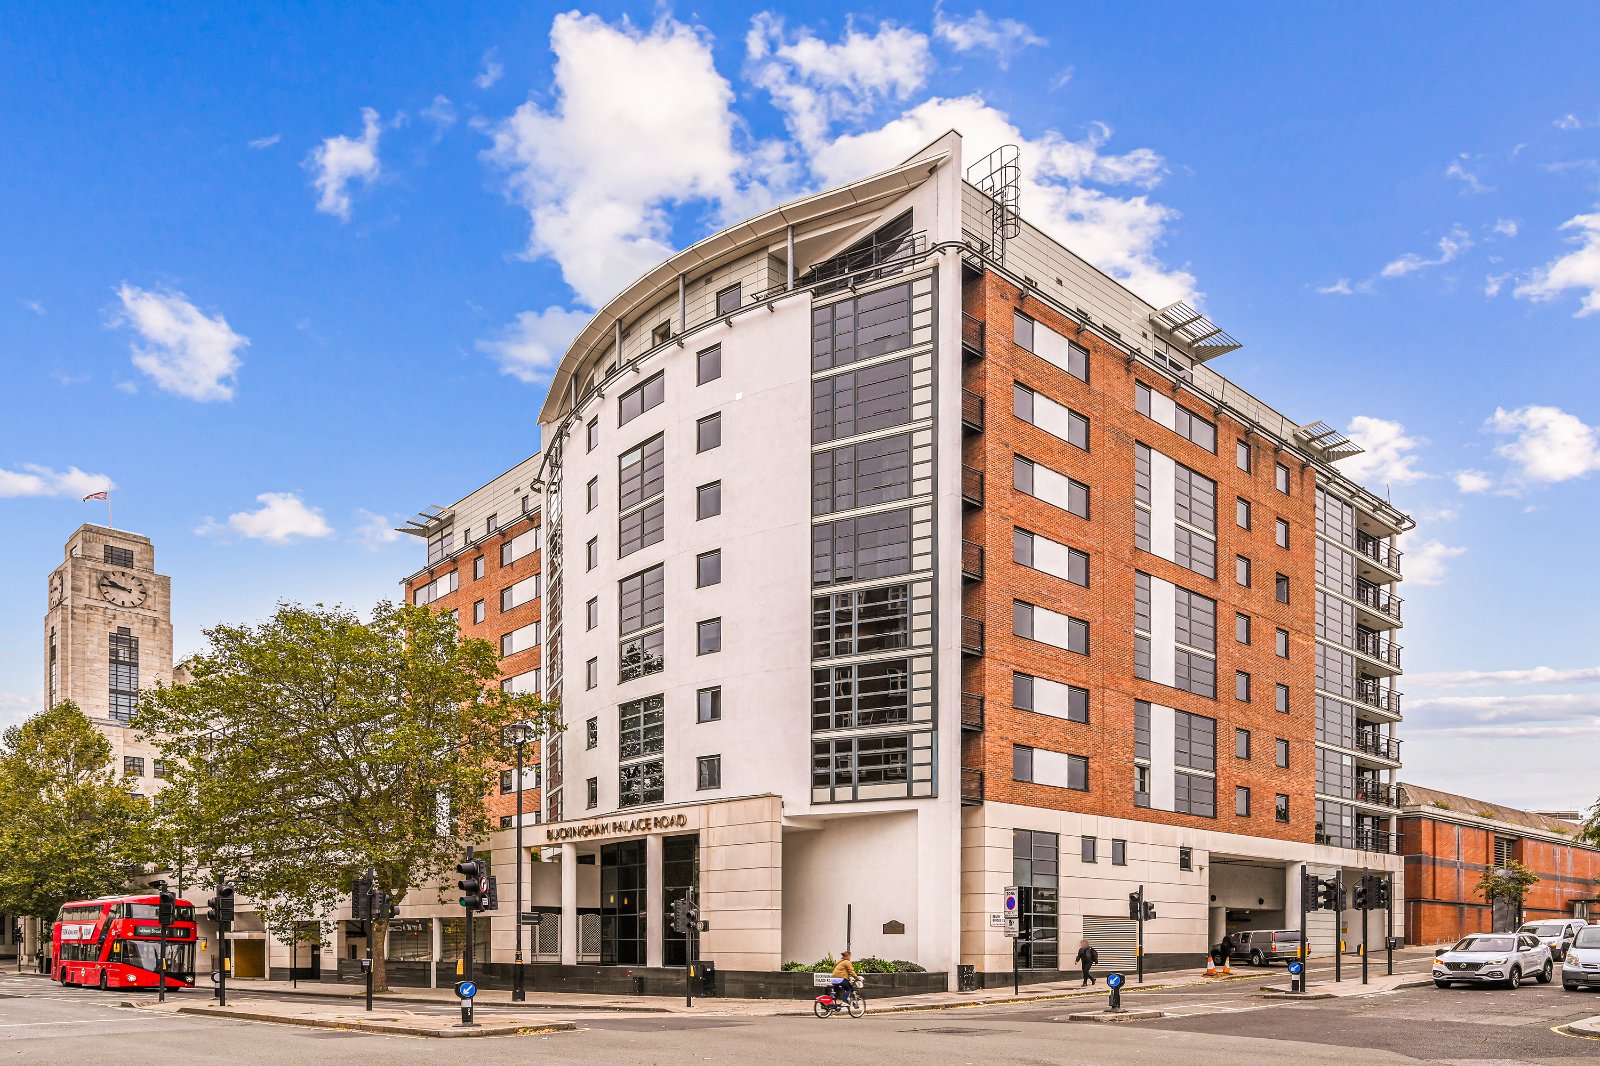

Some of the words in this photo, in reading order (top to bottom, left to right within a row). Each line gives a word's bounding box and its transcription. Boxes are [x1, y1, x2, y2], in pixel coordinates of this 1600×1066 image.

[546, 823, 609, 840] BUCKINGHAM
[612, 817, 652, 832] PALACE
[653, 814, 687, 829] ROAD
